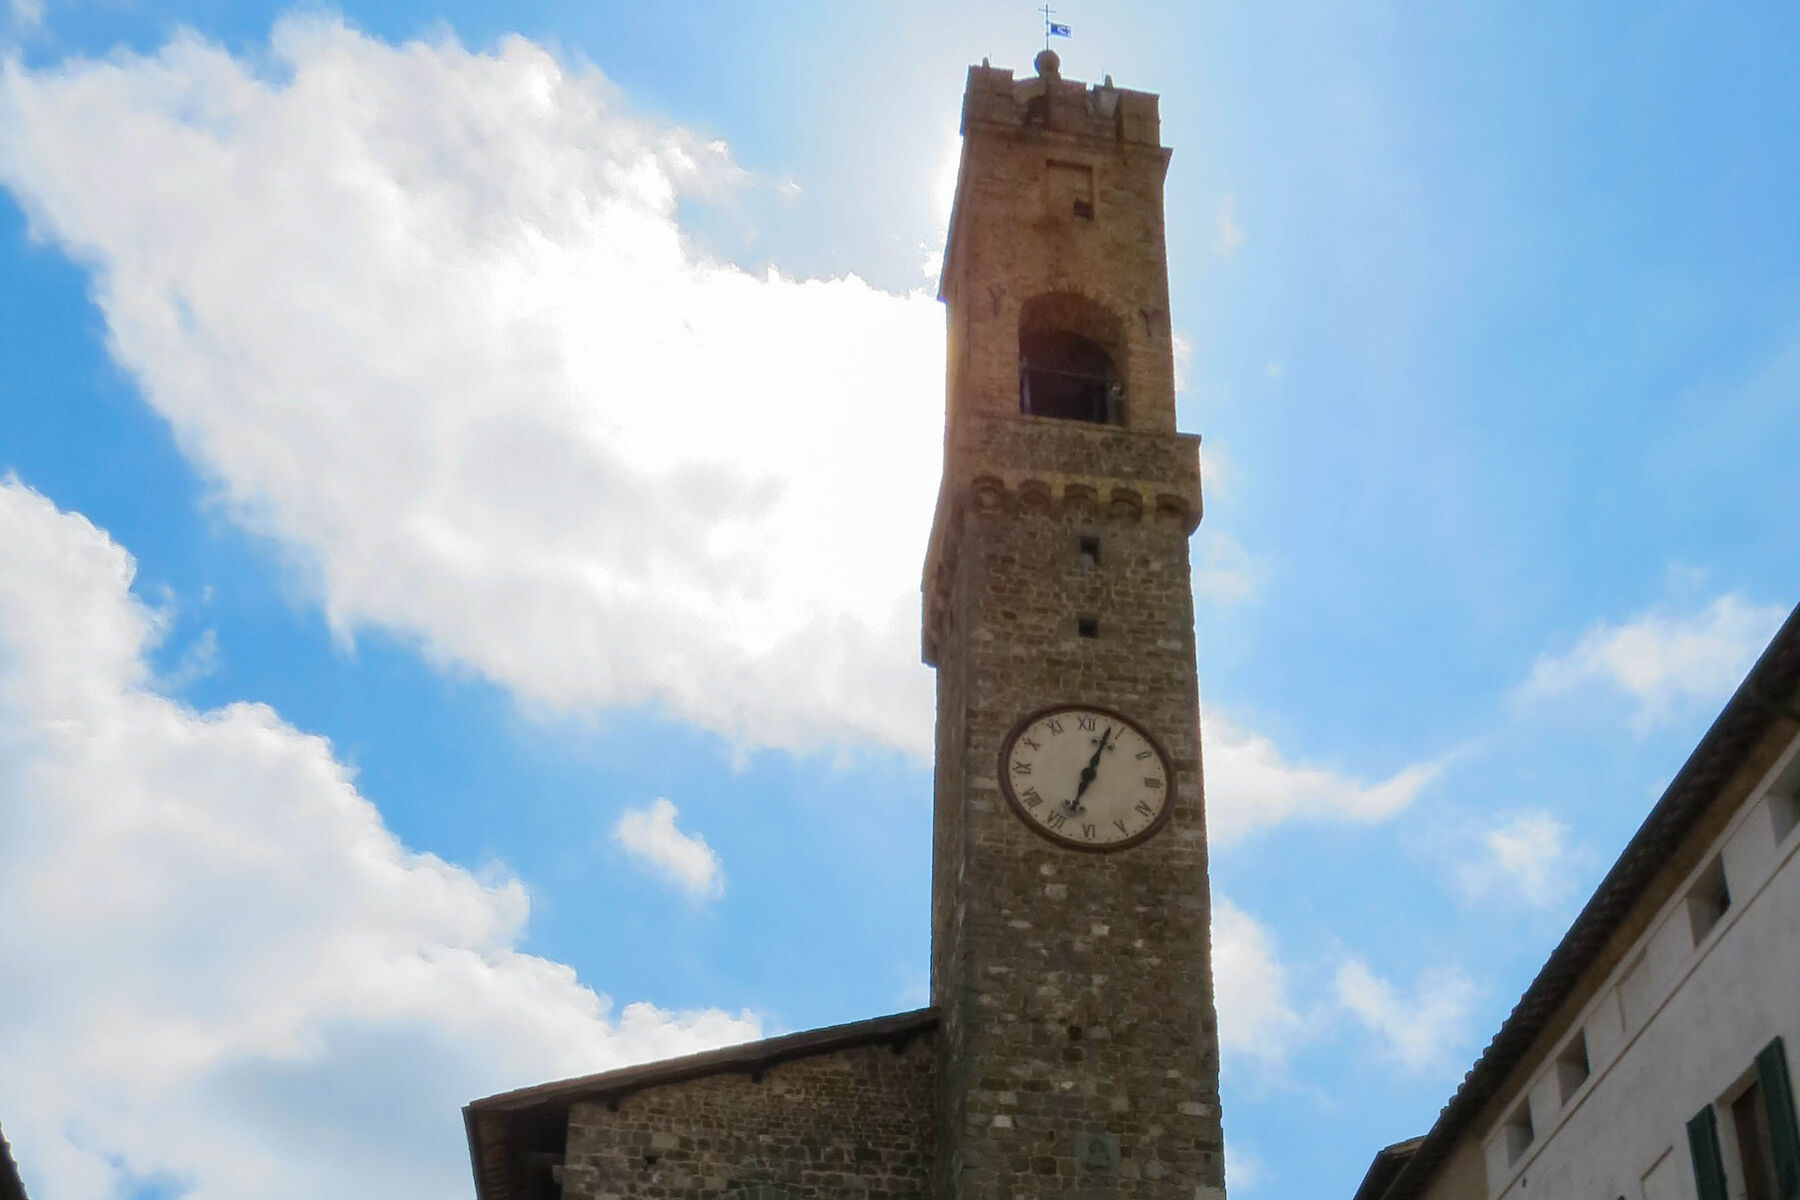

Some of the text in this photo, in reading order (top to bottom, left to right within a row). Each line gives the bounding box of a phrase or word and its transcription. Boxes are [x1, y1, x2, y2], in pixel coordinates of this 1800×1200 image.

[1023, 738, 1041, 751] X
[1082, 823, 1095, 838] VI
[1113, 820, 1126, 833] V
